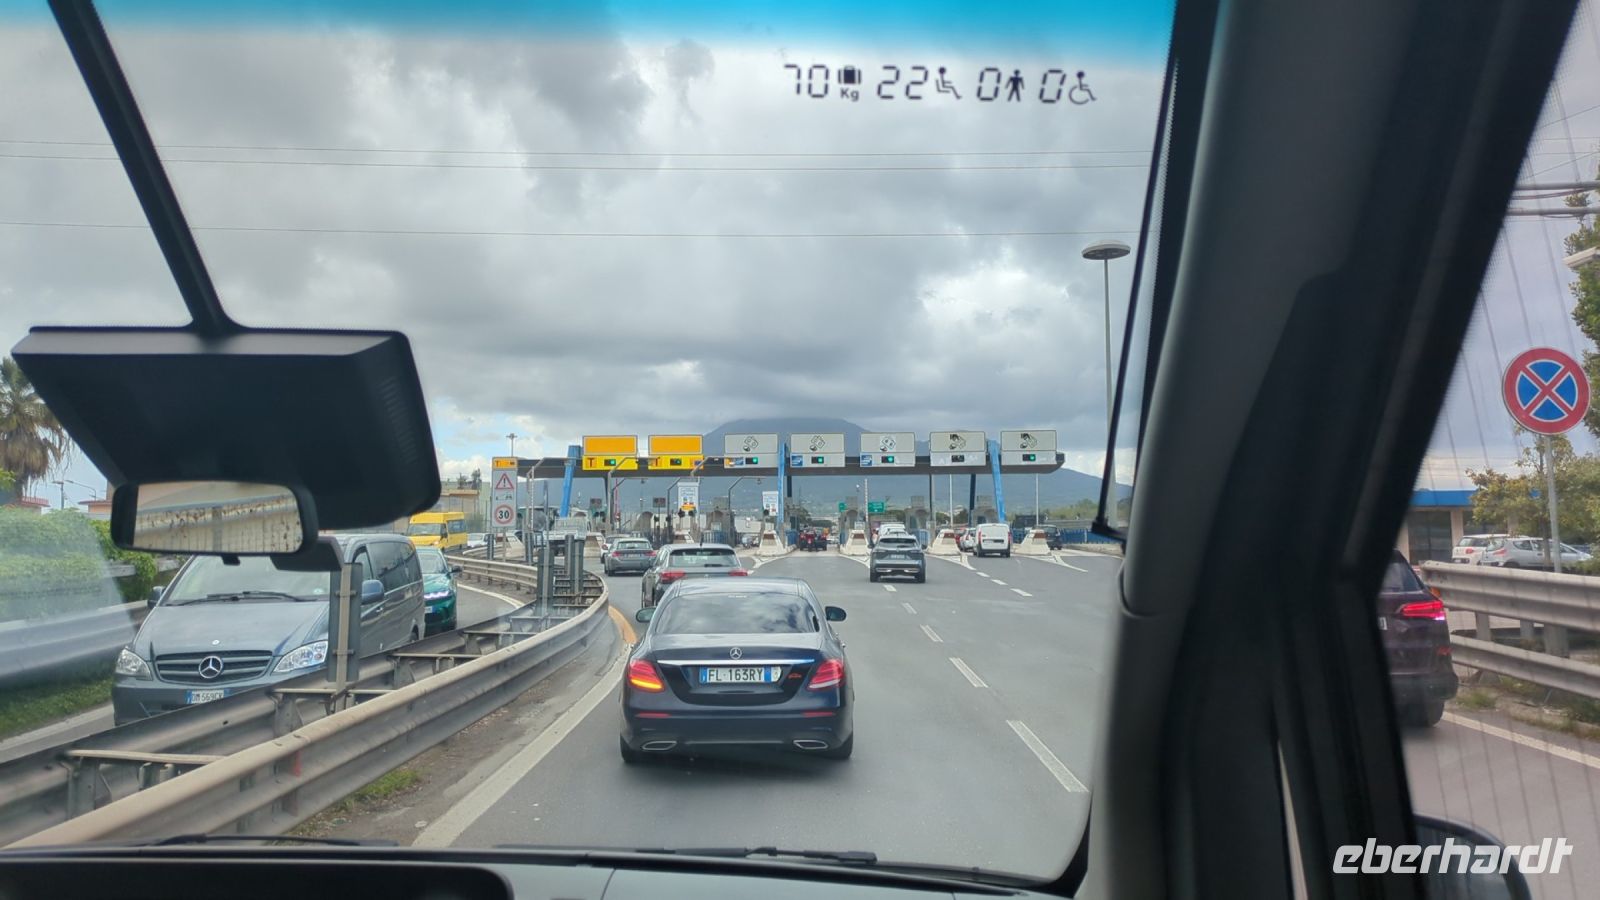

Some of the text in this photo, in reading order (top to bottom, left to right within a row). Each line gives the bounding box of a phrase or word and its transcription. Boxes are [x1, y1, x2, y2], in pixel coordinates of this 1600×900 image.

[784, 64, 1066, 103] 70 Kg 22 0 0
[498, 510, 510, 519] 30
[708, 669, 722, 681] FL
[729, 669, 763, 681] 163RY
